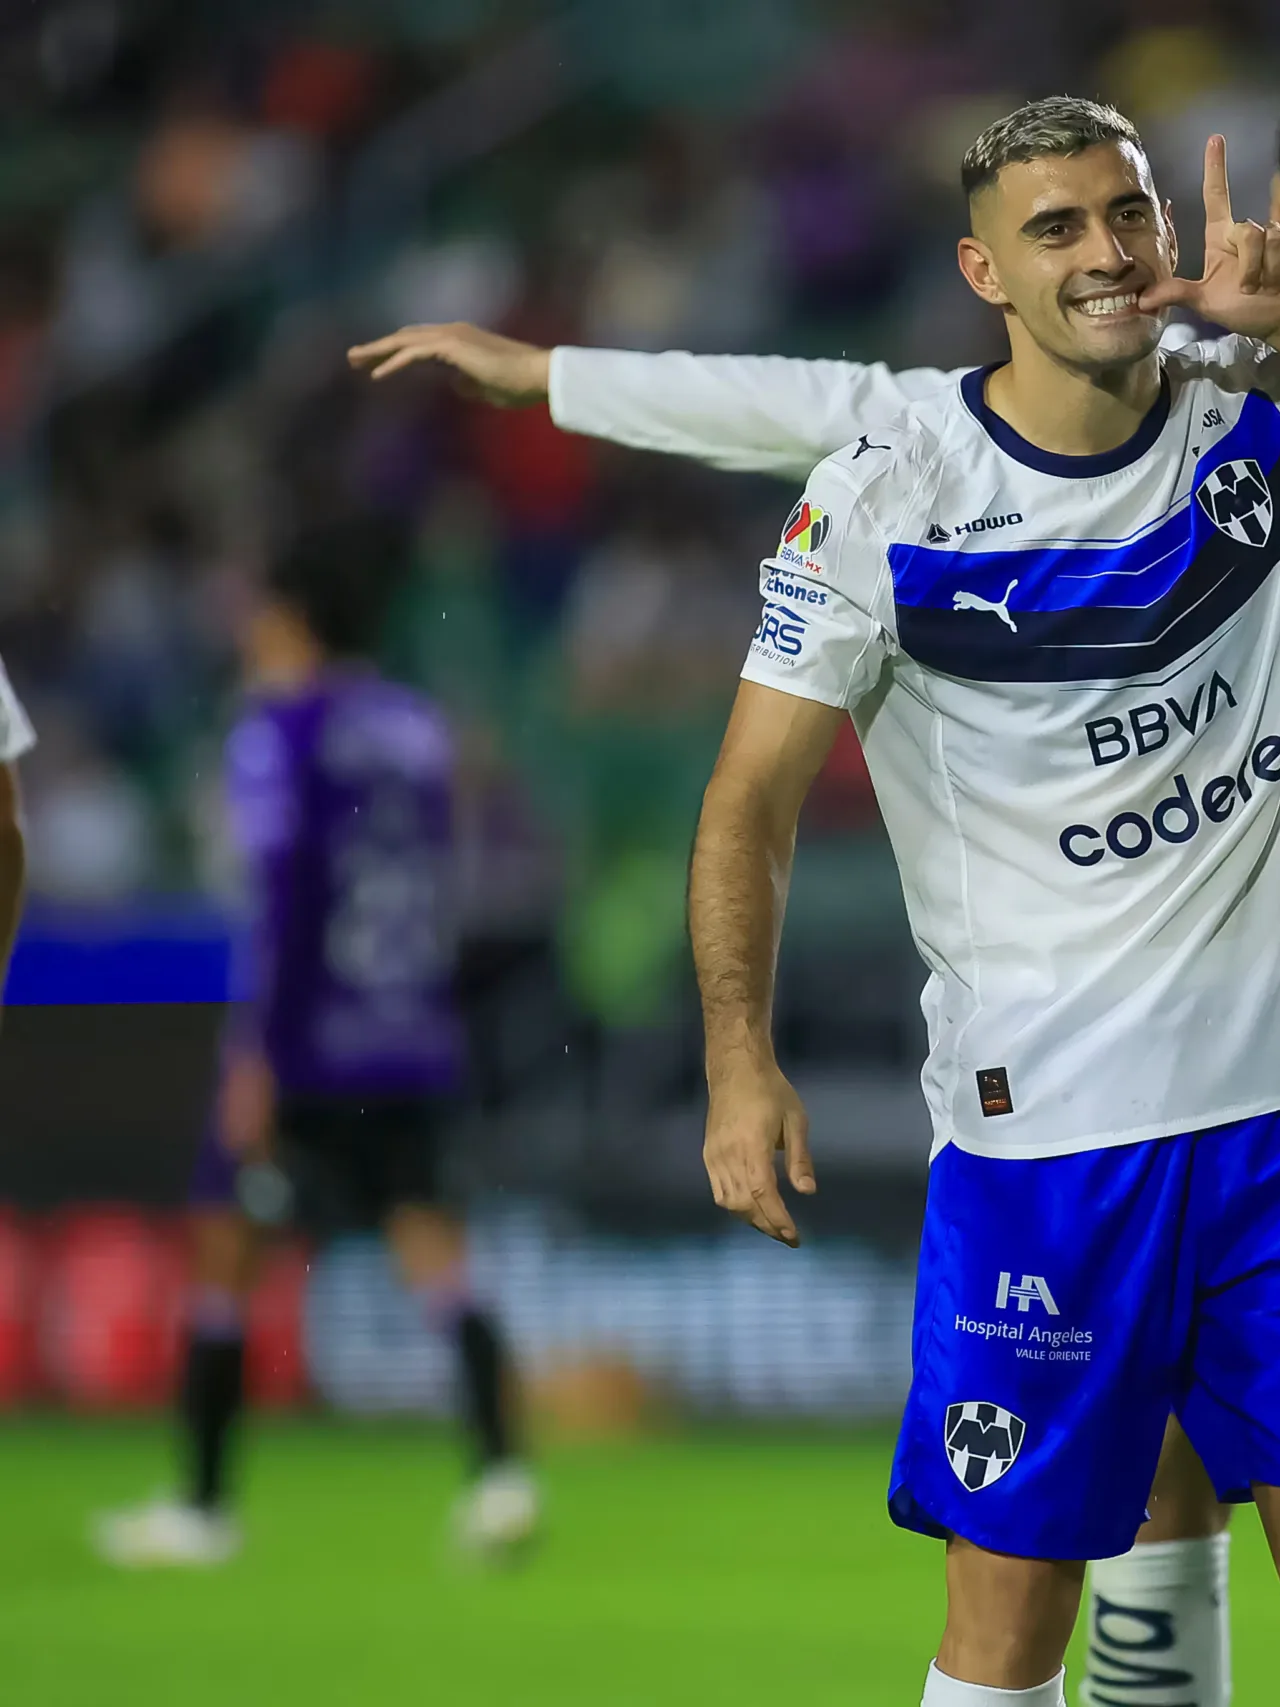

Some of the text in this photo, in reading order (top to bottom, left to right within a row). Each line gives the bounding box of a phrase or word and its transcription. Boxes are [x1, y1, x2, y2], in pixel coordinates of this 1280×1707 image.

[954, 512, 1023, 536] HOWO
[804, 560, 822, 574] MX
[1084, 669, 1238, 767] BBVA
[954, 1314, 1093, 1347] Hospital Angeles
[1016, 1348, 1092, 1361] VALLE ORIENTE
